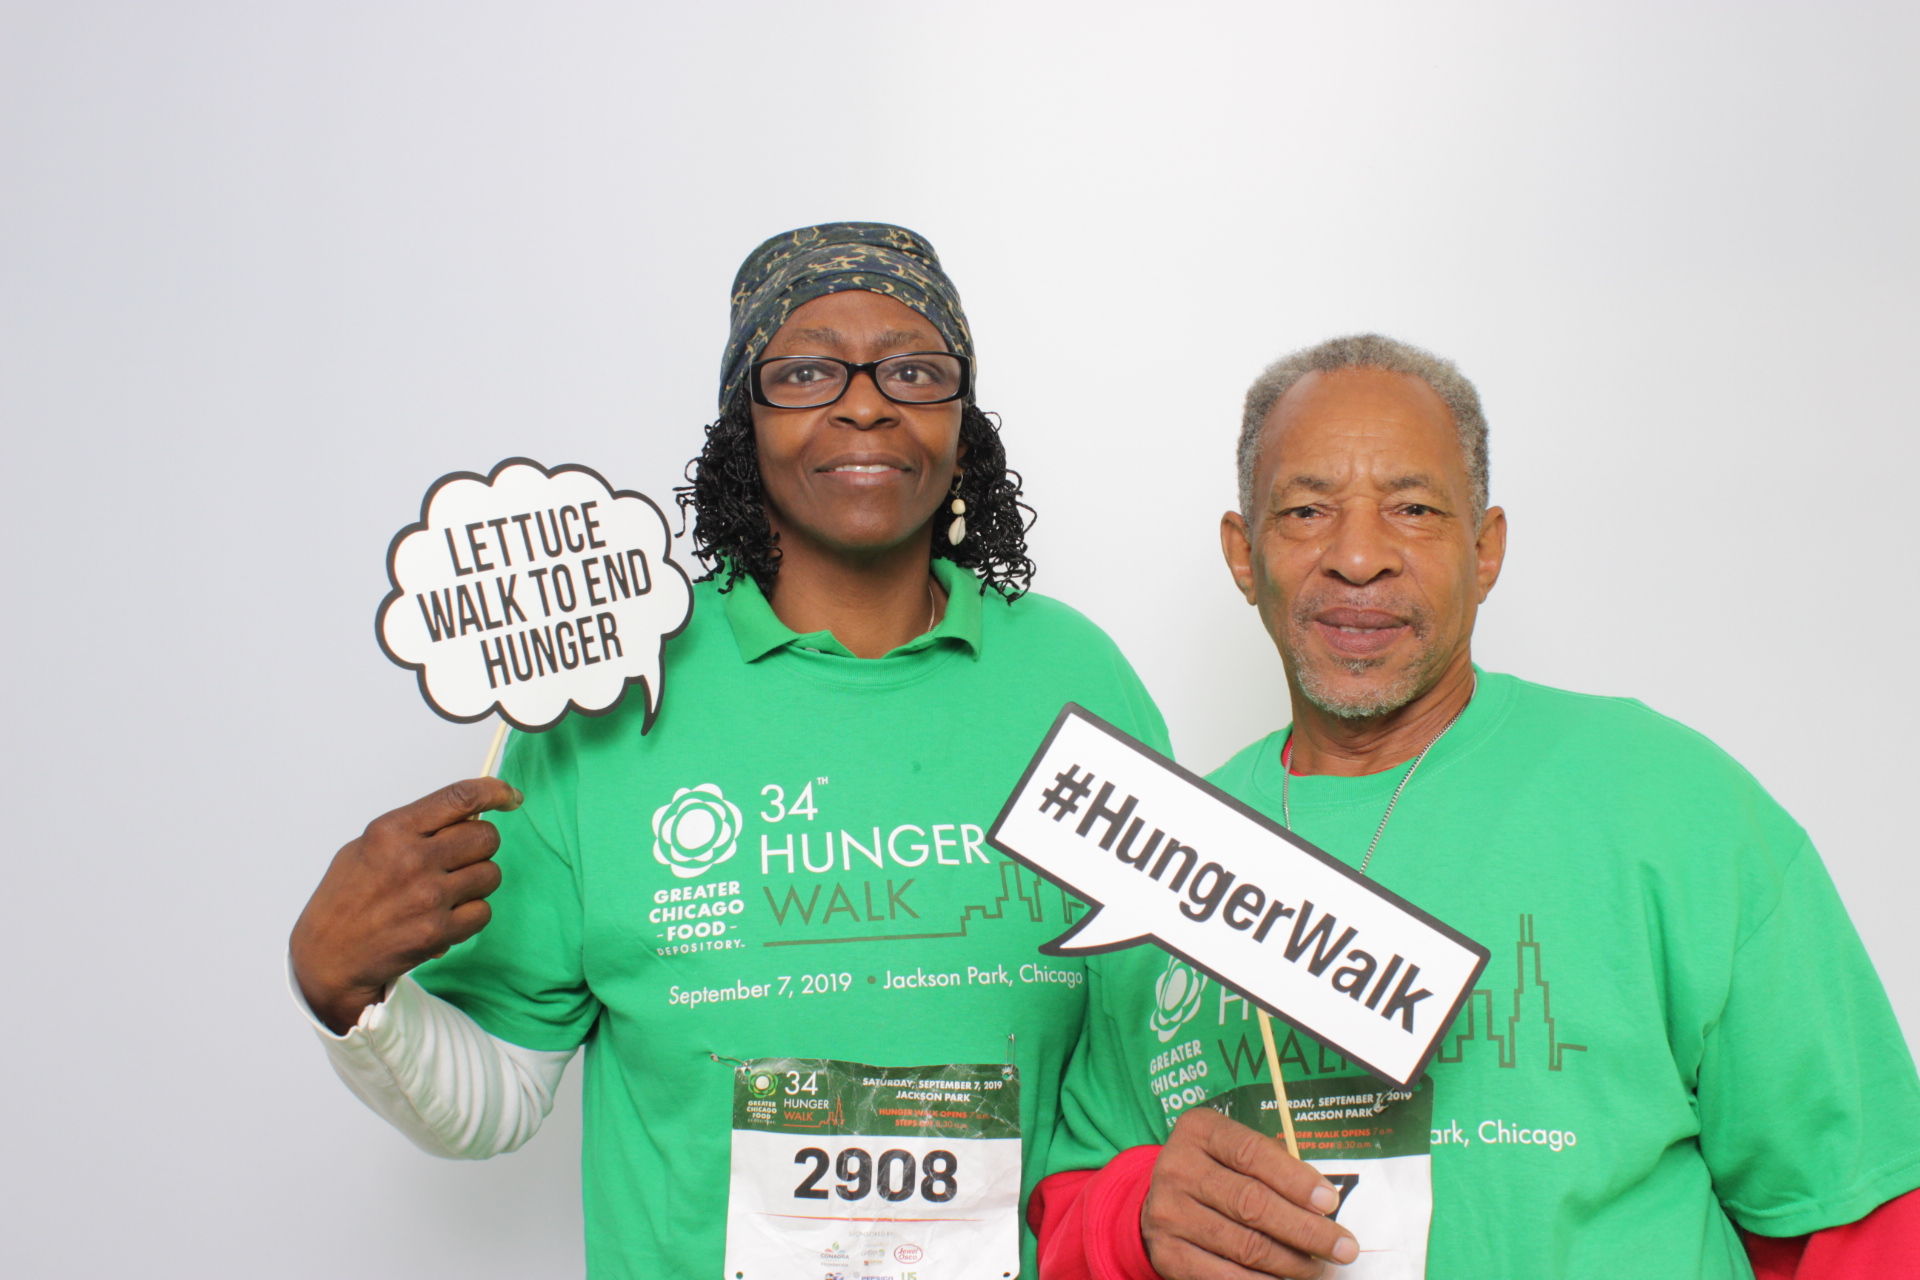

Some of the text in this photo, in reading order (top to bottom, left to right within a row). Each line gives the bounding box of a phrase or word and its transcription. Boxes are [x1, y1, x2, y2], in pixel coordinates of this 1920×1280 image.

[444, 500, 606, 577] LETTUCE
[416, 548, 652, 642] WALK TO END
[480, 612, 623, 689] HUNGER
[761, 824, 990, 874] HUNGER
[654, 881, 740, 904] GREATER
[762, 879, 920, 926] WALK
[1038, 764, 1434, 1034] #HungerWalk
[649, 899, 744, 924] CHICAGO
[669, 963, 1083, 1009] September 7, 2019 Jackson Park, Chicago
[1150, 1040, 1202, 1075] GREATER
[1218, 1028, 1346, 1085] WAL
[862, 1077, 915, 1089] SATURDAY,
[918, 1080, 972, 1091] SEPTEMBER
[984, 1081, 1003, 1091] 2019
[1151, 1060, 1208, 1096] CHICAGO
[783, 1098, 829, 1109] HUNGER
[895, 1090, 970, 1102] JACKSON PARK
[1260, 1098, 1315, 1110] SATRDAY,
[1318, 1093, 1374, 1107] SEPTEMBER
[1387, 1091, 1412, 1101] 2019
[746, 1106, 778, 1114] CHICAGO
[784, 1111, 814, 1121] WALK
[879, 1108, 912, 1116] HUNGER
[940, 1110, 967, 1118] OPENS
[1295, 1107, 1373, 1121] JACKSON PARK
[895, 1119, 917, 1127] STEPS
[1314, 1130, 1340, 1138] WALK
[1341, 1129, 1371, 1137] OPENS
[1430, 1119, 1577, 1152] ark, Chicago
[1298, 1141, 1317, 1149] TEPS
[1318, 1141, 1335, 1149] OFF
[1337, 1141, 1355, 1149] 8:30
[794, 1147, 958, 1203] 2908
